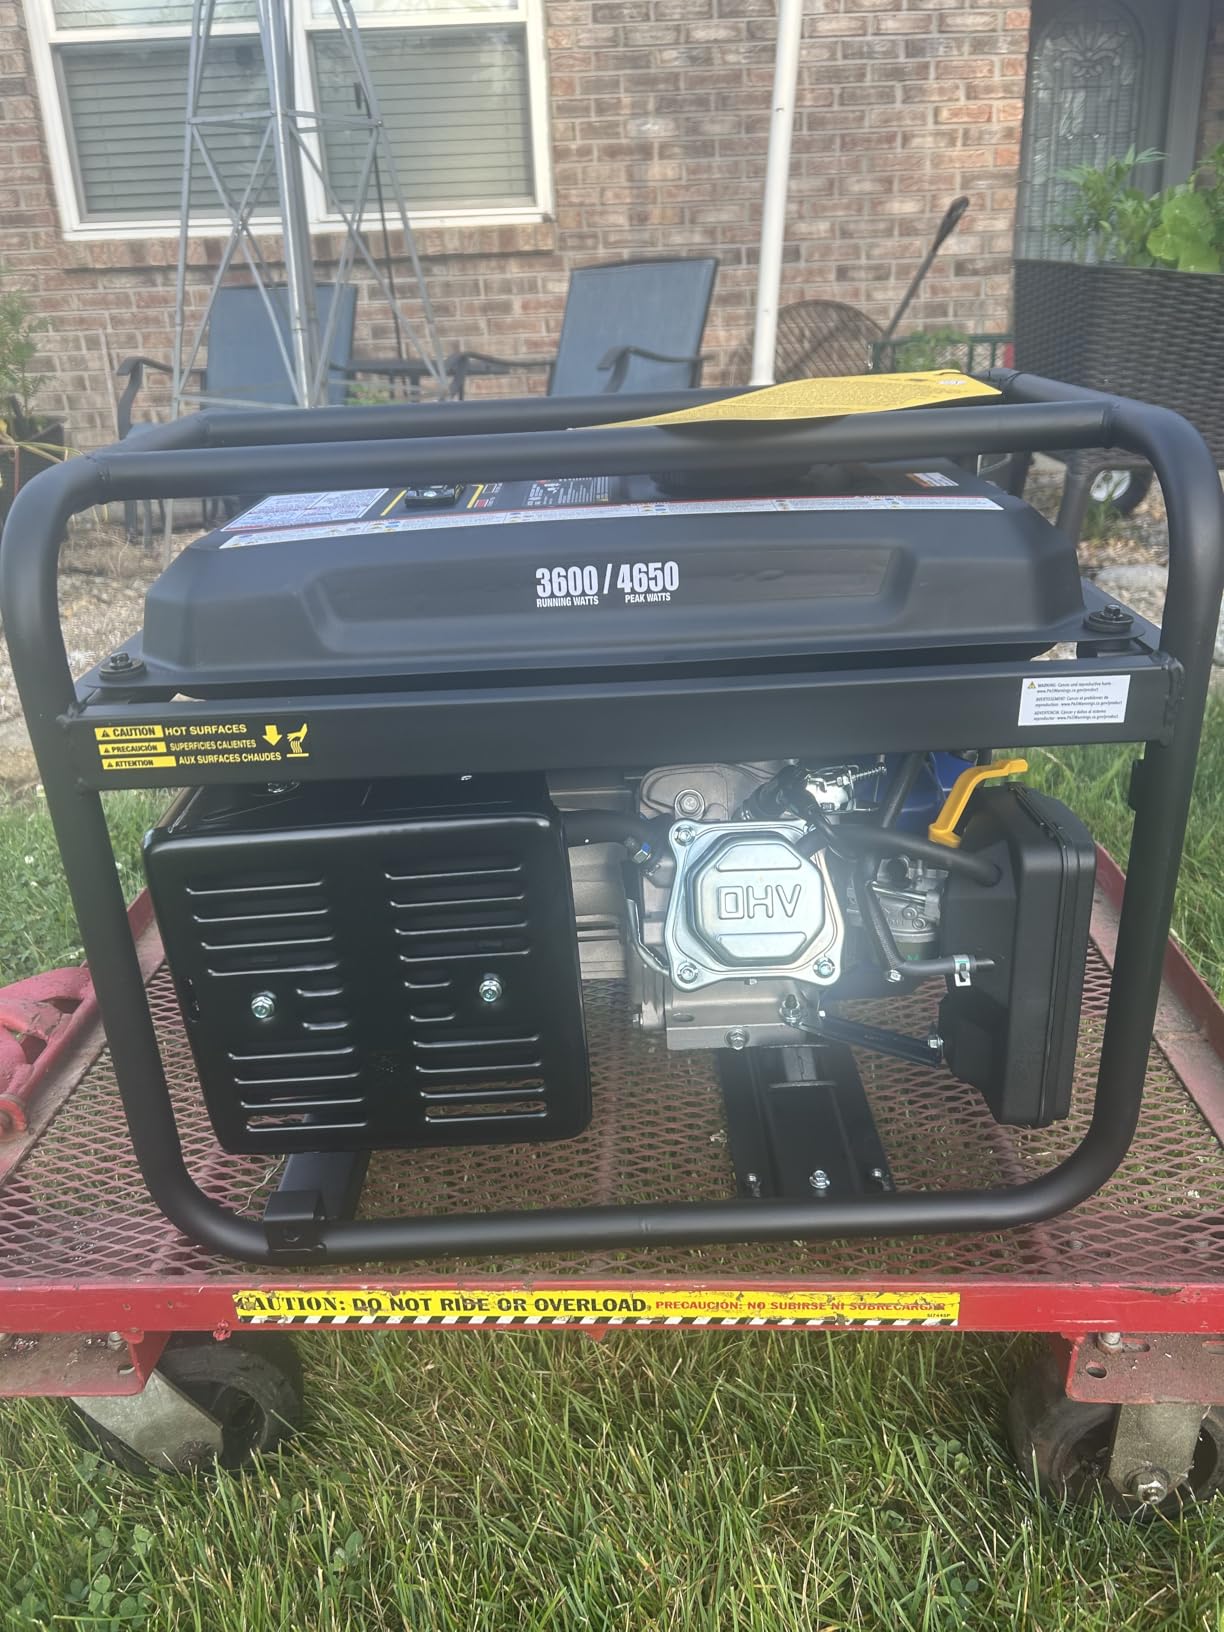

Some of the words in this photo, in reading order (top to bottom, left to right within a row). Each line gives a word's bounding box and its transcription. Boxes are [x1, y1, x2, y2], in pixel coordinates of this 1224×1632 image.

[535, 565, 599, 598] 3600
[616, 561, 679, 593] 4650
[536, 597, 572, 608] RUNNING
[573, 595, 599, 606] WATTS
[625, 593, 645, 603] PEAK
[646, 592, 671, 602] WATTS
[112, 727, 156, 737] CAUTION
[165, 726, 187, 736] HOT
[190, 724, 247, 735] SURFACES
[170, 741, 217, 751] SUPERFICIES
[217, 739, 257, 749] CALIENTES
[179, 756, 196, 765] AUX
[197, 754, 241, 764] SURFACES
[242, 752, 282, 762] CHAUDES
[718, 884, 802, 920] OHV
[352, 1298, 382, 1312] DO
[390, 1298, 431, 1311] NOT
[440, 1298, 490, 1312] RIDE
[498, 1298, 527, 1311] OR
[747, 1302, 766, 1310] NO
[770, 1301, 826, 1310] SUBIRSE
[831, 1301, 845, 1310] NI
